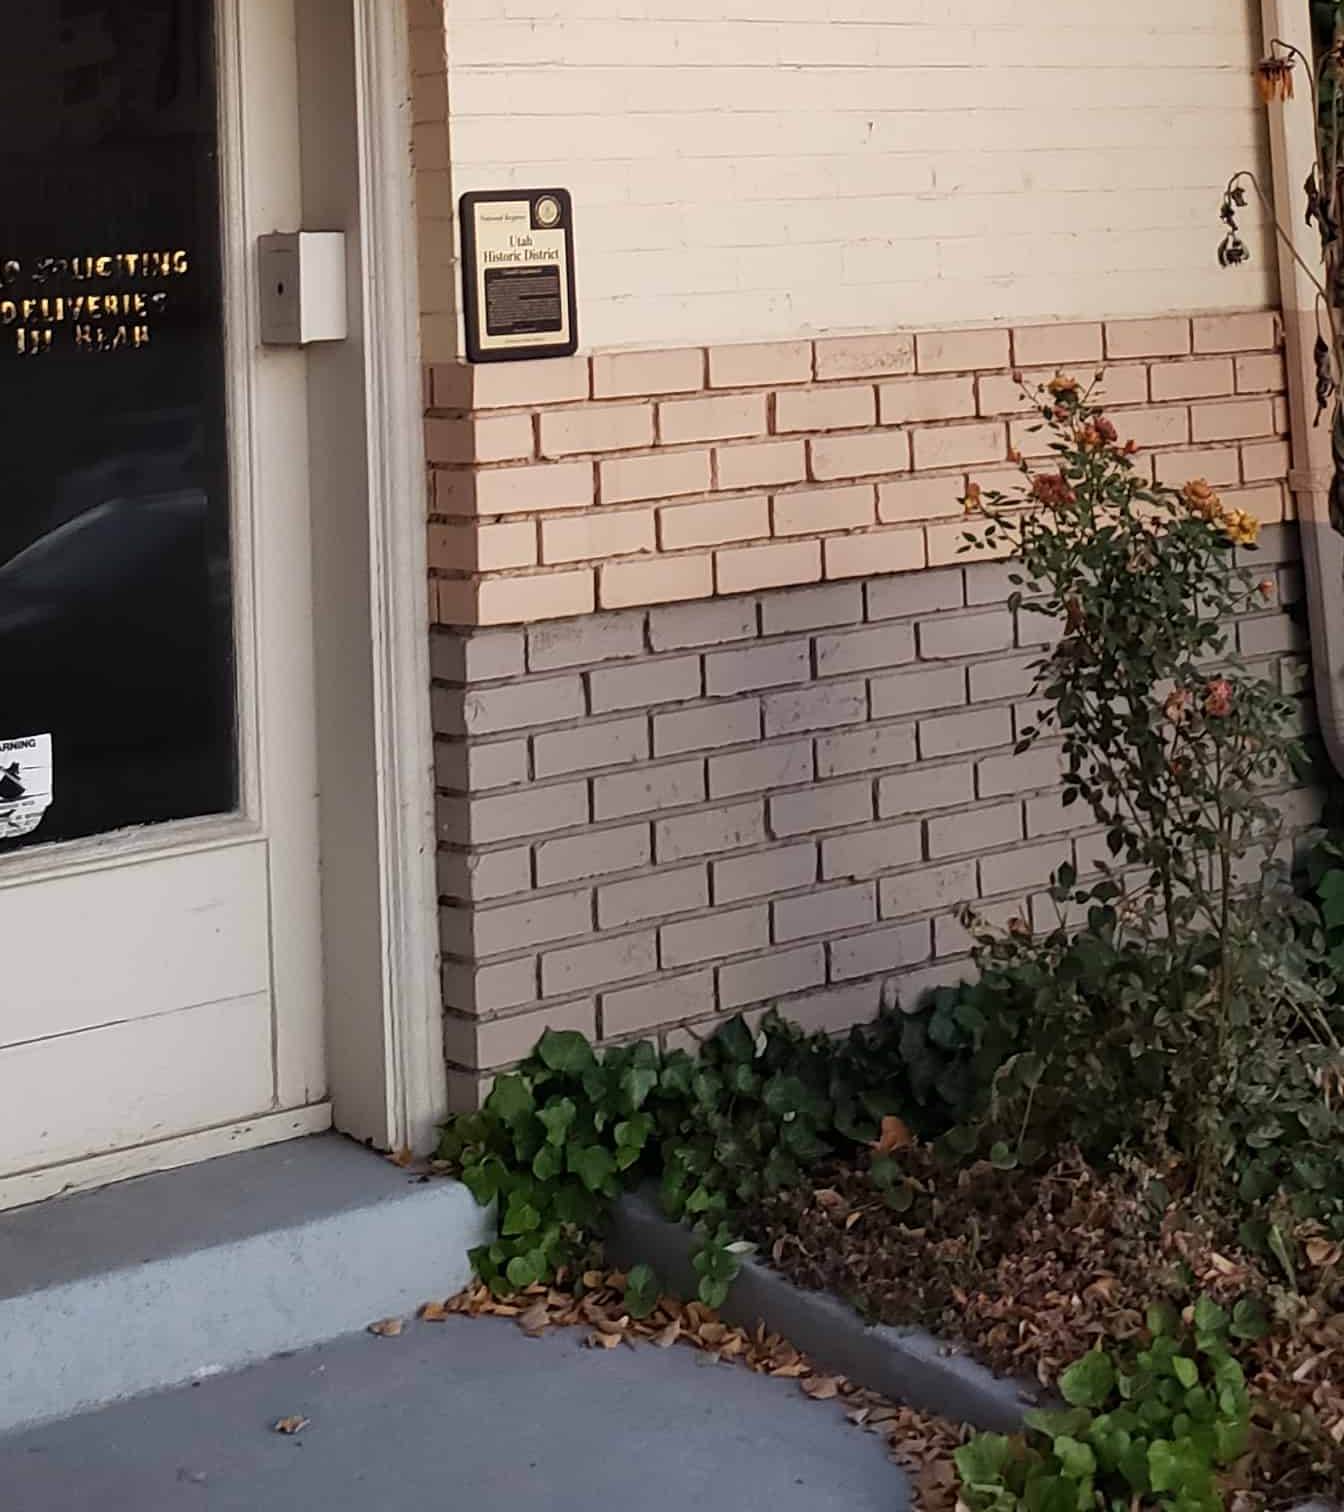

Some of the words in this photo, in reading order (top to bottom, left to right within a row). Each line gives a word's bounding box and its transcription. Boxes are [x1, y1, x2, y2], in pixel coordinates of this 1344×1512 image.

[509, 234, 534, 248] Utah
[483, 250, 522, 264] Historic
[524, 248, 560, 262] District
[32, 249, 190, 284] SLICTING
